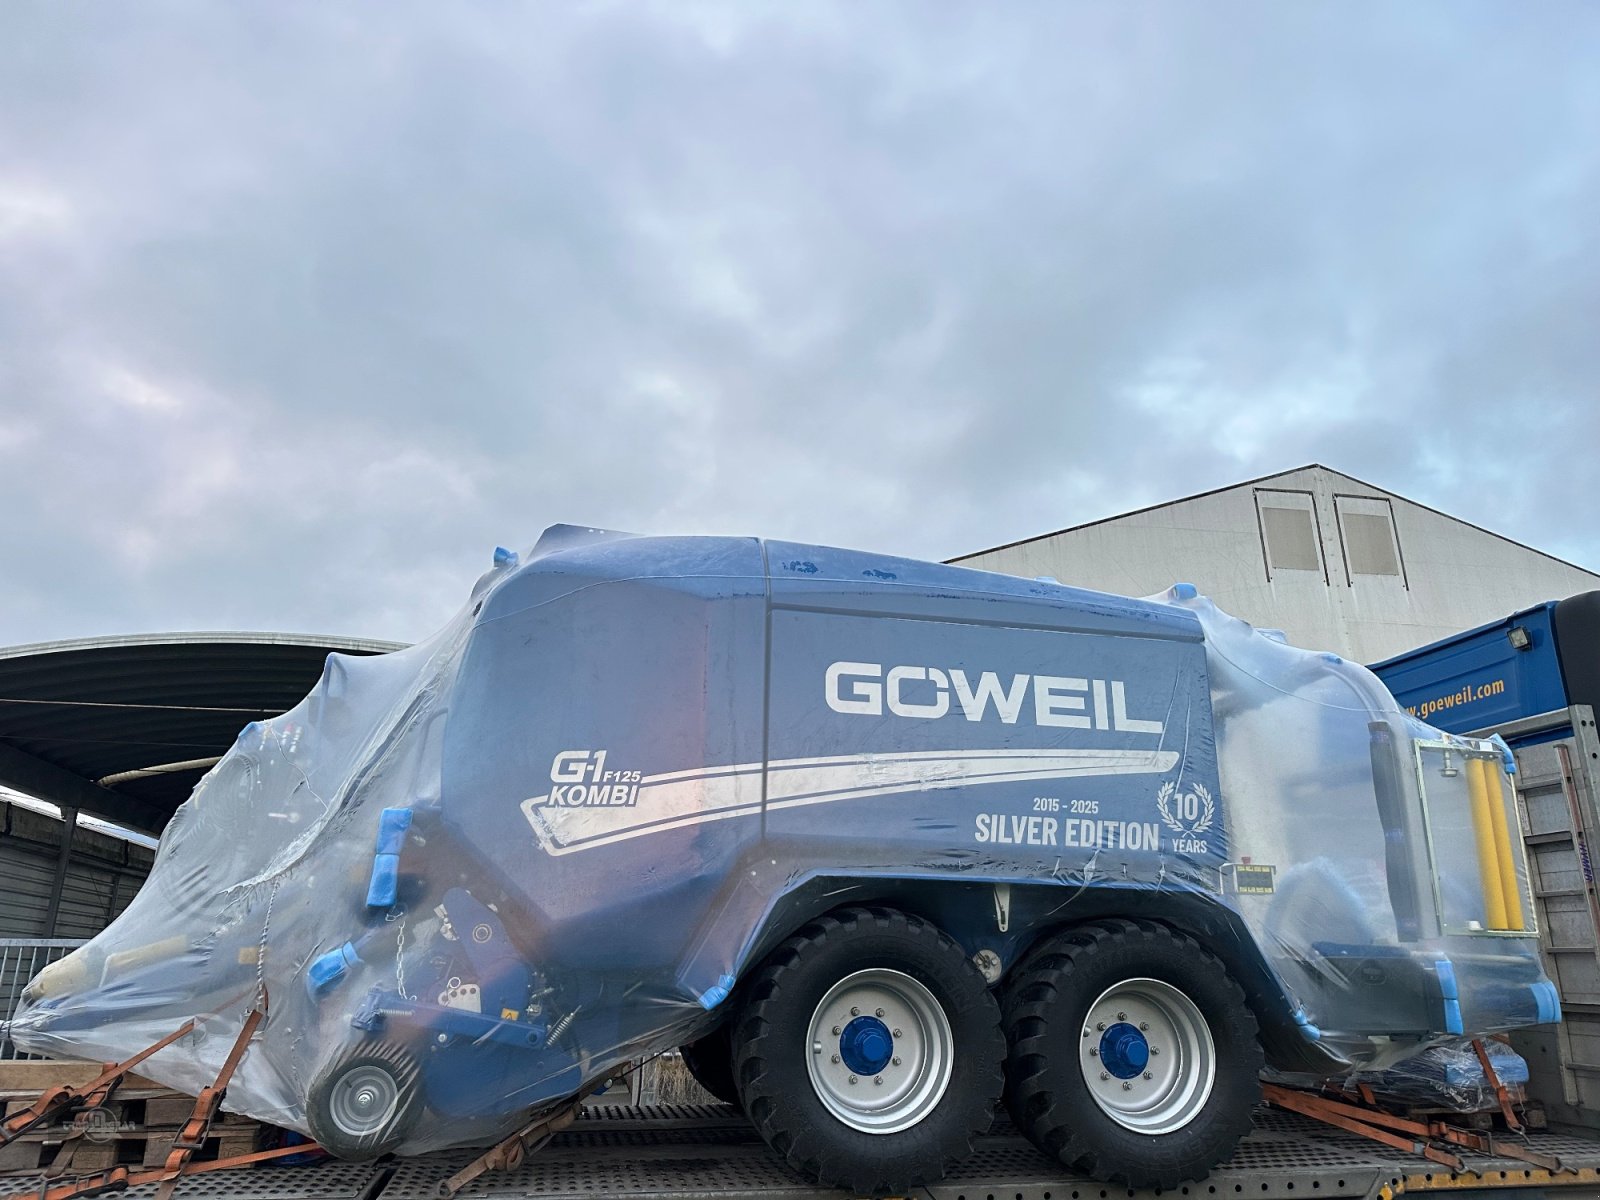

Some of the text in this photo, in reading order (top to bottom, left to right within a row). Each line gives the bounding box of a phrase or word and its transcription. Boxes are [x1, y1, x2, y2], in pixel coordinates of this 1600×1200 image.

[1405, 678, 1505, 719] w.goeweil.com
[602, 770, 642, 783] F125
[548, 784, 639, 806] KOMBI
[1032, 797, 1060, 812] 2015
[1070, 799, 1099, 814] 2025
[1172, 793, 1198, 820] 10
[974, 813, 1159, 851] SILVER EDITION
[1172, 838, 1208, 854] YEARS
